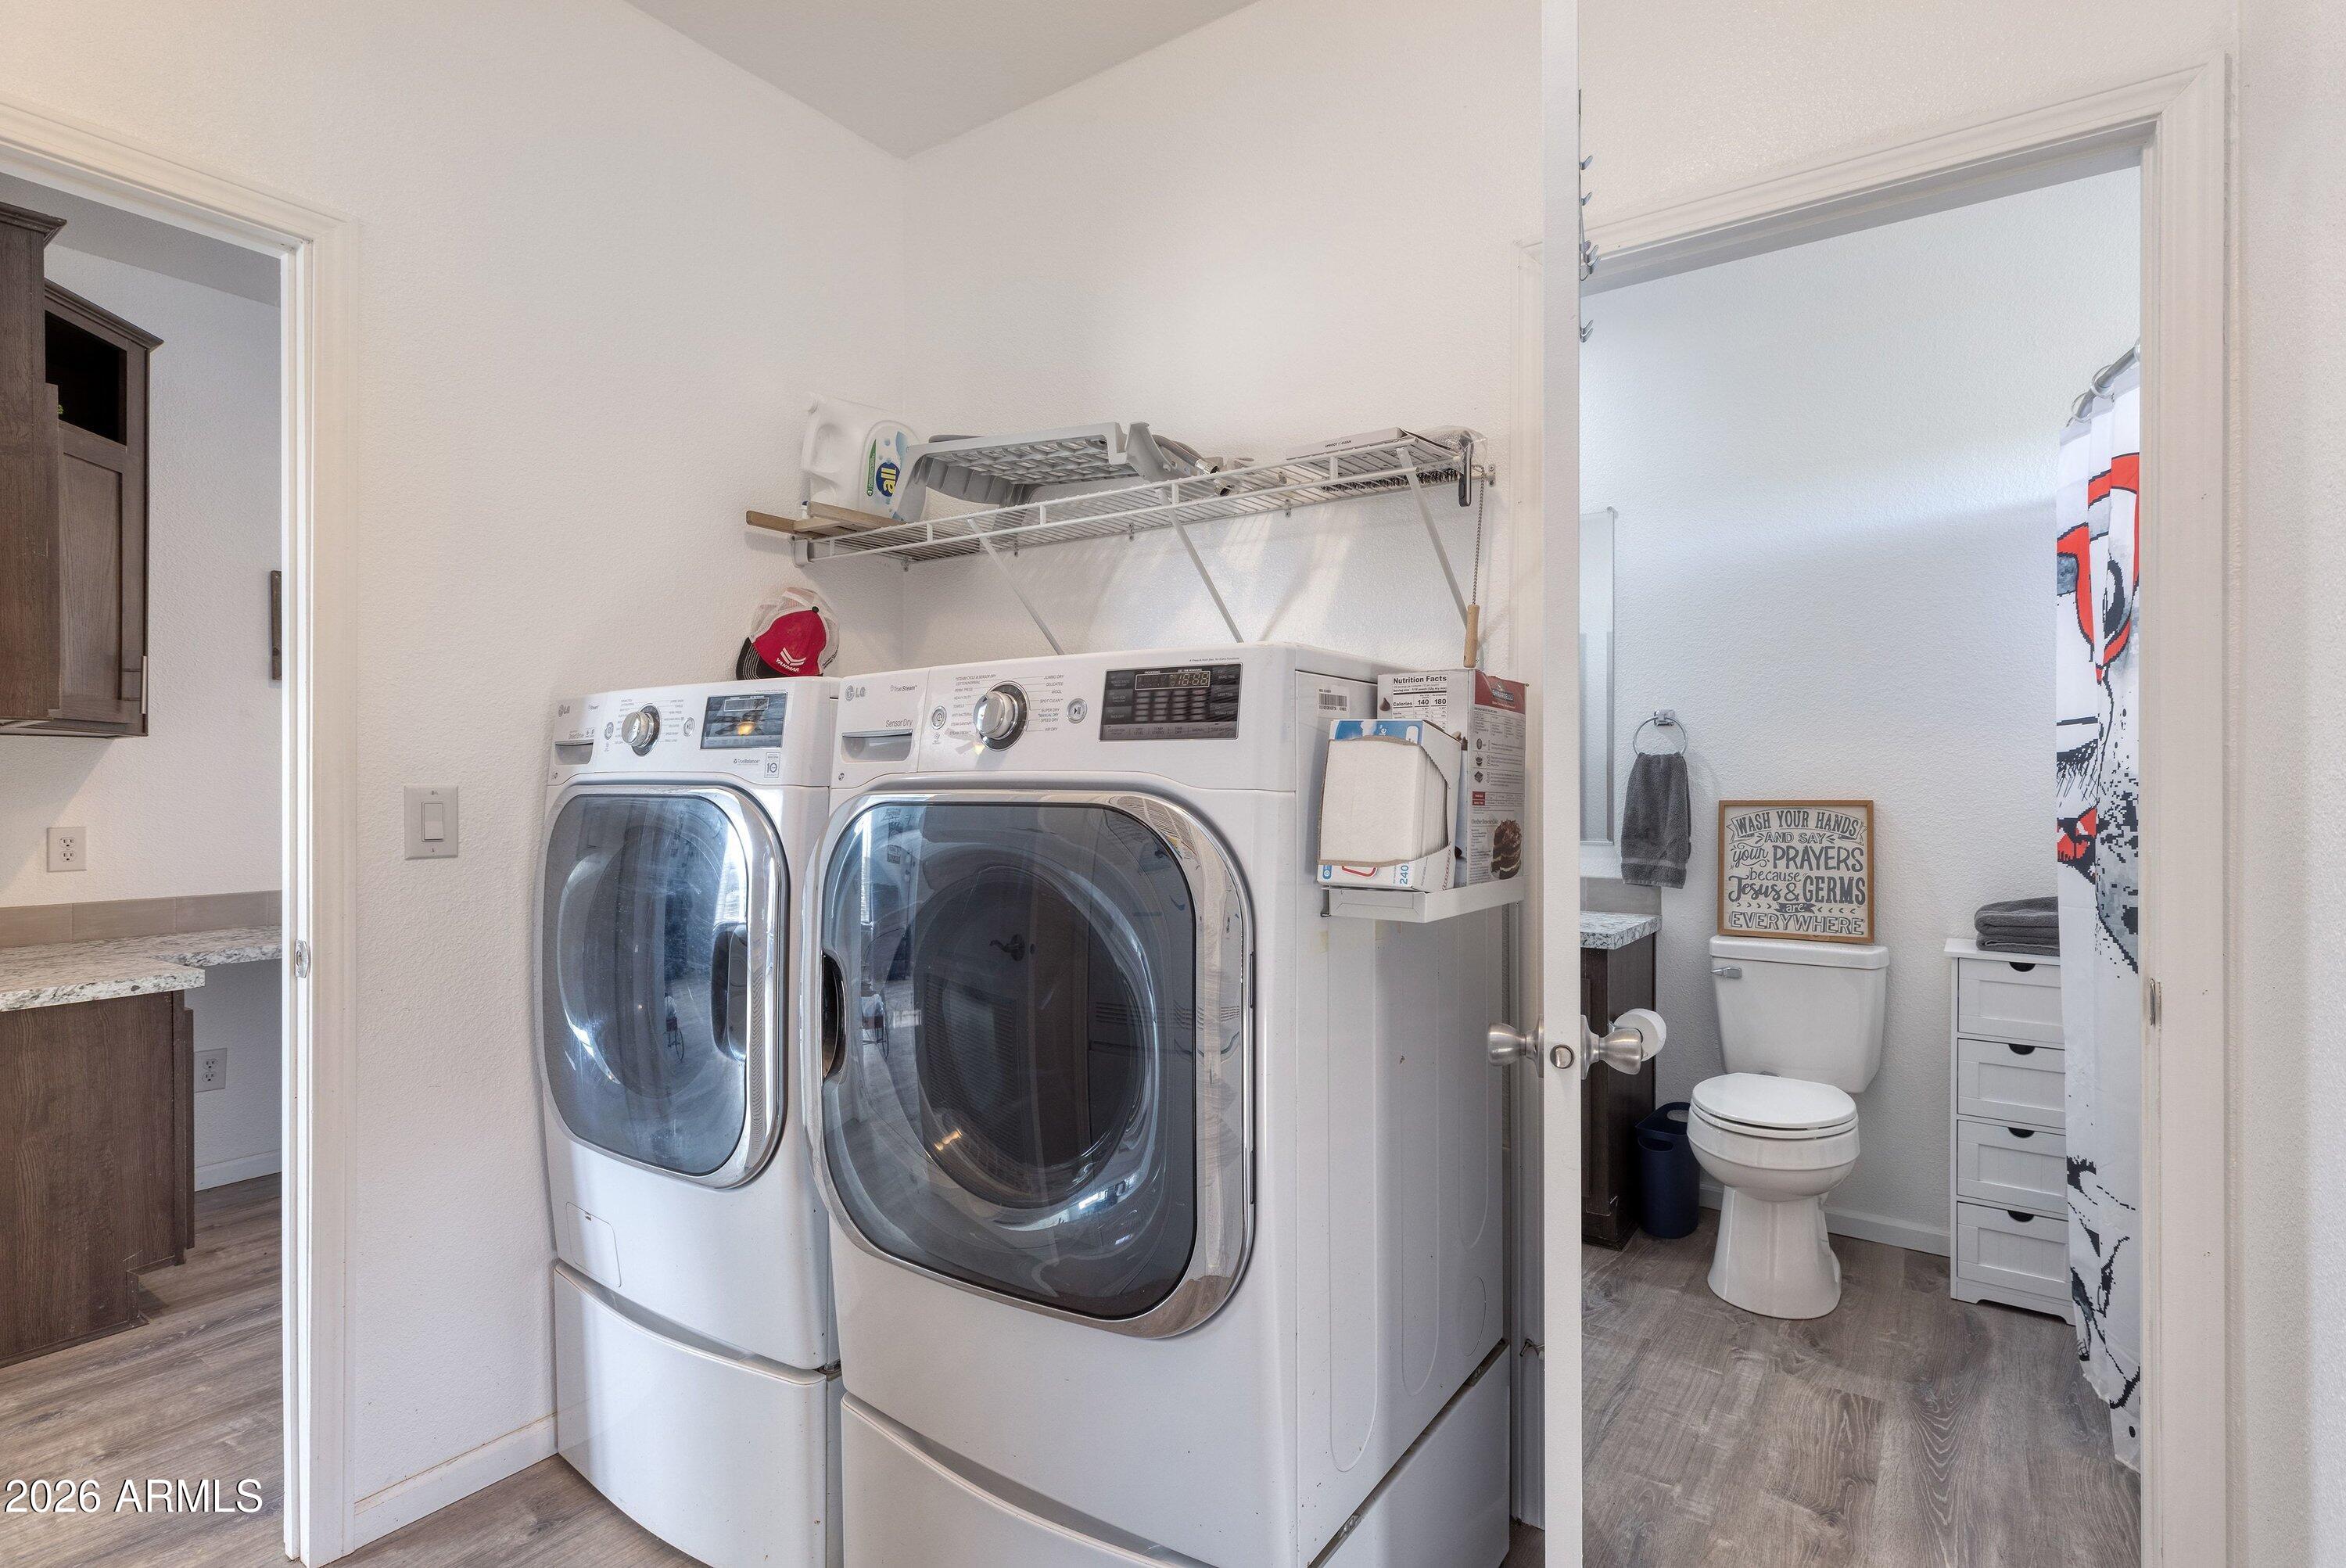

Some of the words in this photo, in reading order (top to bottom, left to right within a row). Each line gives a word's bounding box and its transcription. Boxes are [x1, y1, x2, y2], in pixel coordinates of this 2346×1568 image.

[881, 467, 897, 494] all
[775, 658, 800, 673] YANMAR
[856, 687, 866, 698] LG
[885, 719, 902, 728] Sensor
[902, 719, 913, 728] Dry
[767, 762, 777, 773] 10
[1735, 812, 1770, 837] WASH
[1776, 810, 1810, 828] YOUR
[1815, 812, 1859, 837] HANDS
[1764, 832, 1794, 844] AND
[1798, 832, 1827, 845] SAY
[1732, 846, 1769, 867] your
[1772, 845, 1864, 873] PRAYERS
[1399, 865, 1409, 885] 240
[1749, 867, 1802, 882] because
[1728, 875, 1782, 902] Jesus
[1784, 882, 1799, 902] &
[1803, 875, 1866, 906] GERMS
[1785, 902, 1806, 913] are
[1731, 911, 1865, 935] EVERYWHERE
